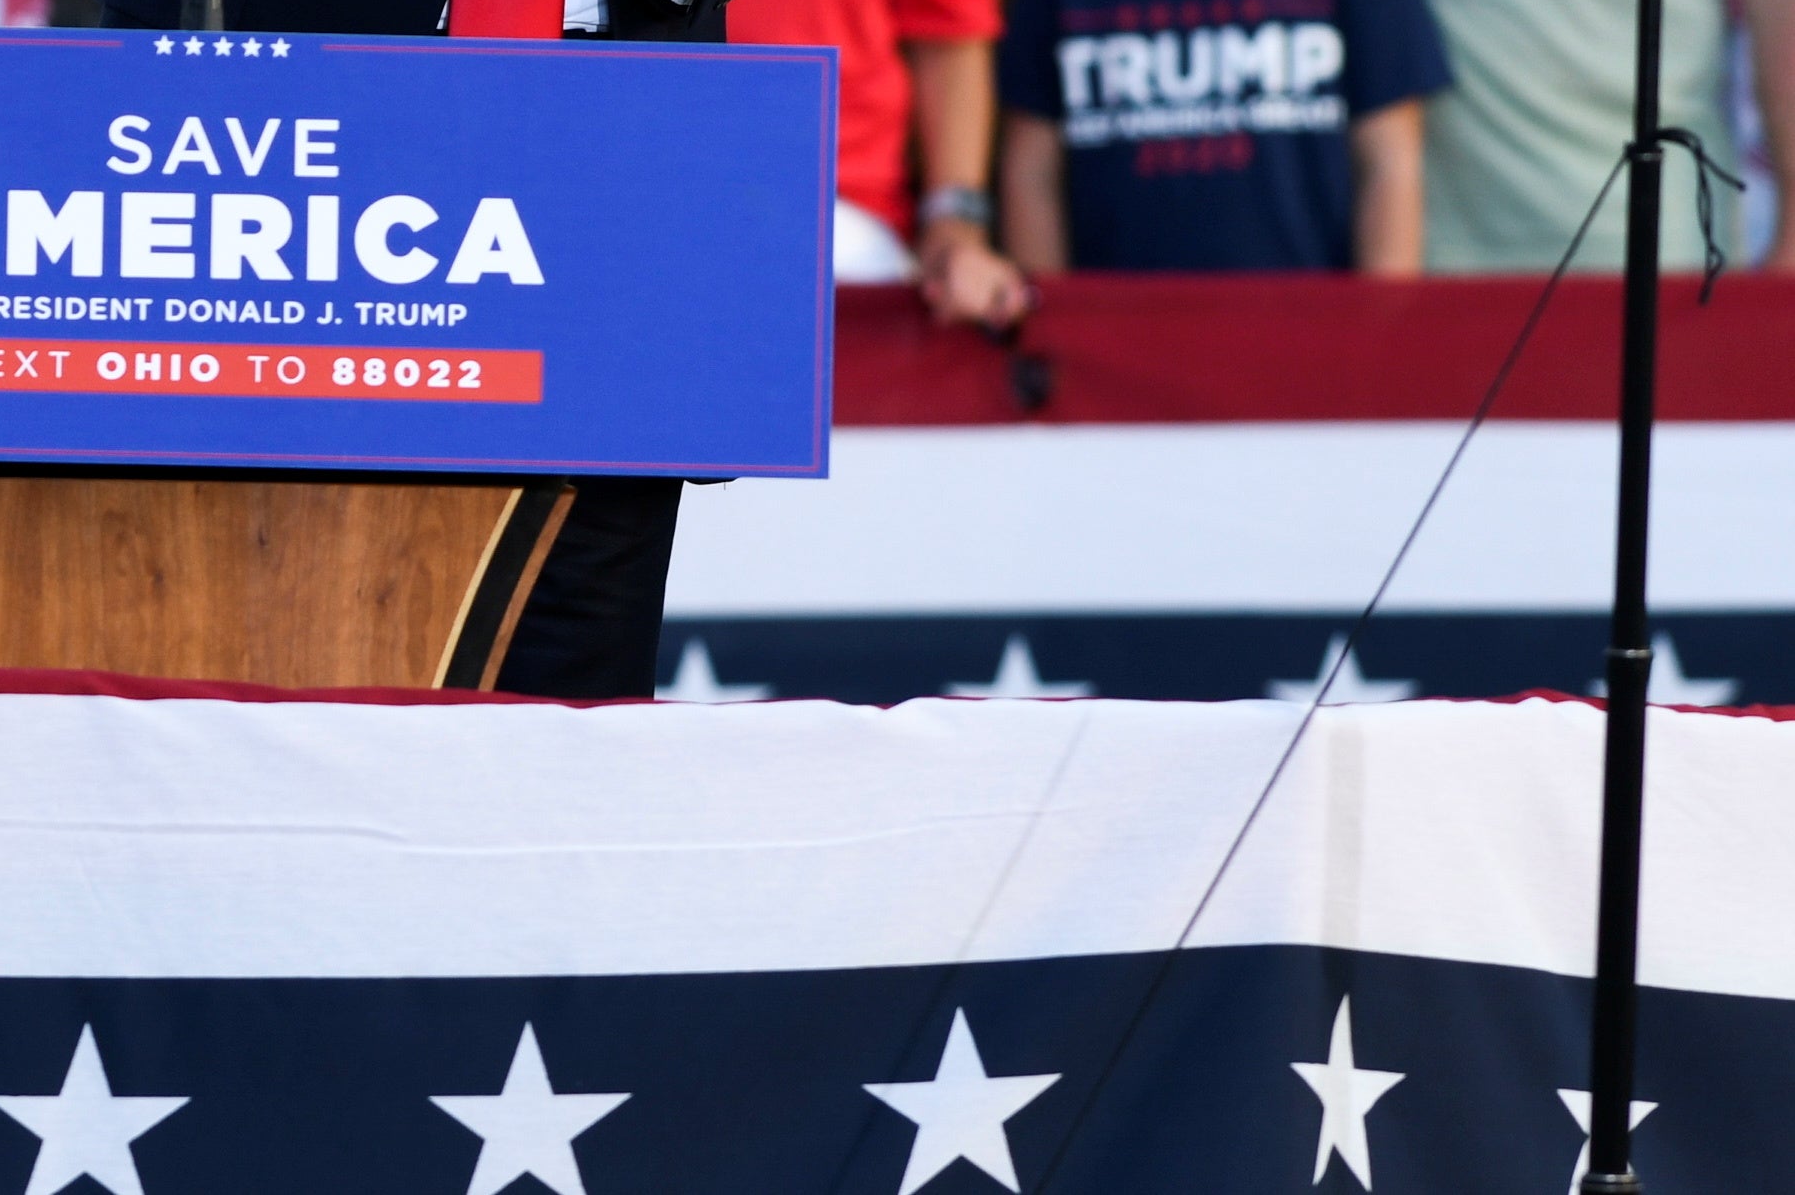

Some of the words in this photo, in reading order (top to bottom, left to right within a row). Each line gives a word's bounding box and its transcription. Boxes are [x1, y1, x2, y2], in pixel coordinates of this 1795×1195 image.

[1056, 21, 1345, 106] TRUMP
[105, 113, 341, 179] SAVE
[164, 297, 306, 325] DONALD
[316, 300, 343, 326] J.
[353, 301, 468, 328] TRUMP
[95, 350, 221, 384] OHIO
[246, 354, 307, 386] TO
[330, 356, 482, 390] 88022
